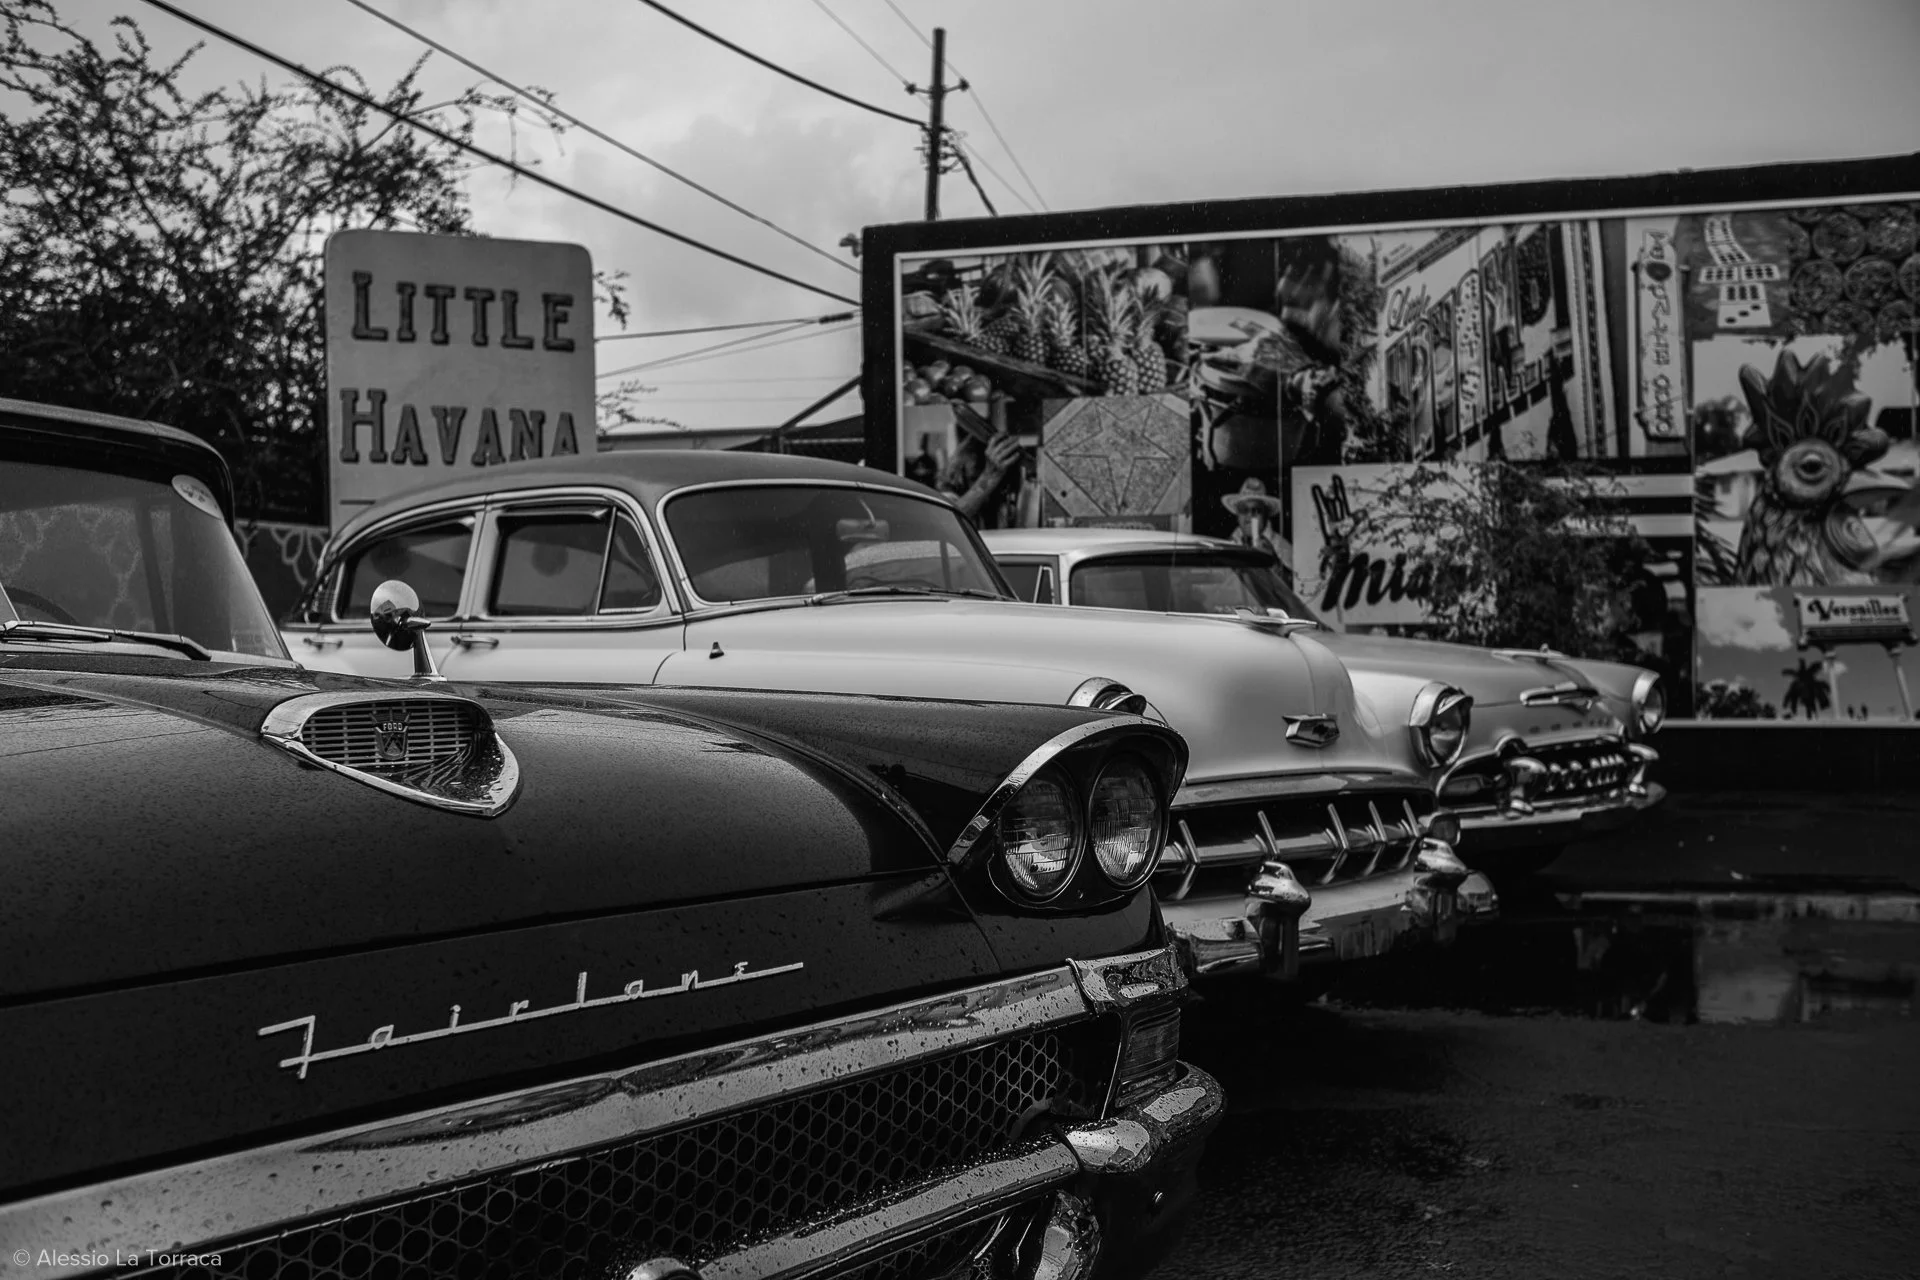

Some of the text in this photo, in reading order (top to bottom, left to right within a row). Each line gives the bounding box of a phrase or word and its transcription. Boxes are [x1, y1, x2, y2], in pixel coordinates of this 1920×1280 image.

[351, 270, 576, 352] LITTLE
[340, 388, 579, 467] HAVANA
[382, 722, 403, 731] FORD
[257, 961, 804, 1080] Fairlane
